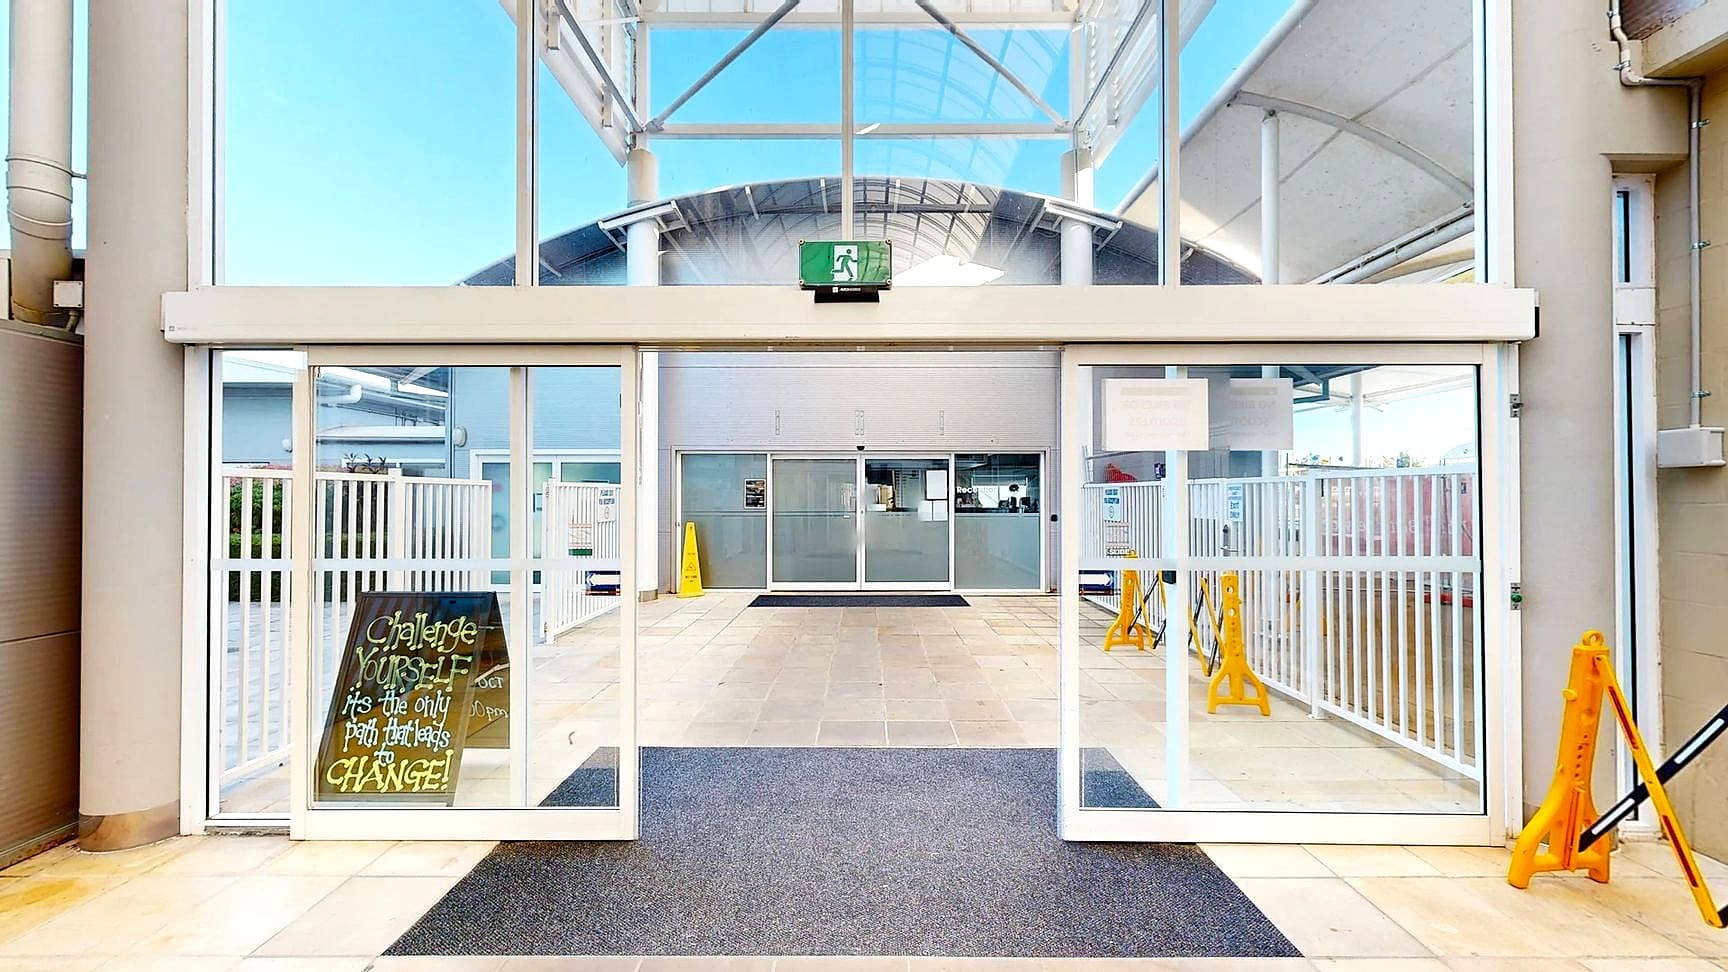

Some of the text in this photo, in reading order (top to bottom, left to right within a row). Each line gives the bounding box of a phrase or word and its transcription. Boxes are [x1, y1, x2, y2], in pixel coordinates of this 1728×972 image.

[366, 611, 478, 653] Challenge
[354, 646, 473, 693] YOURSELF
[478, 676, 504, 689] OCT
[378, 688, 408, 716] the
[414, 690, 451, 726] only
[343, 717, 450, 752] path that leads
[326, 749, 454, 793] CHANGE!
[374, 743, 395, 767] to
